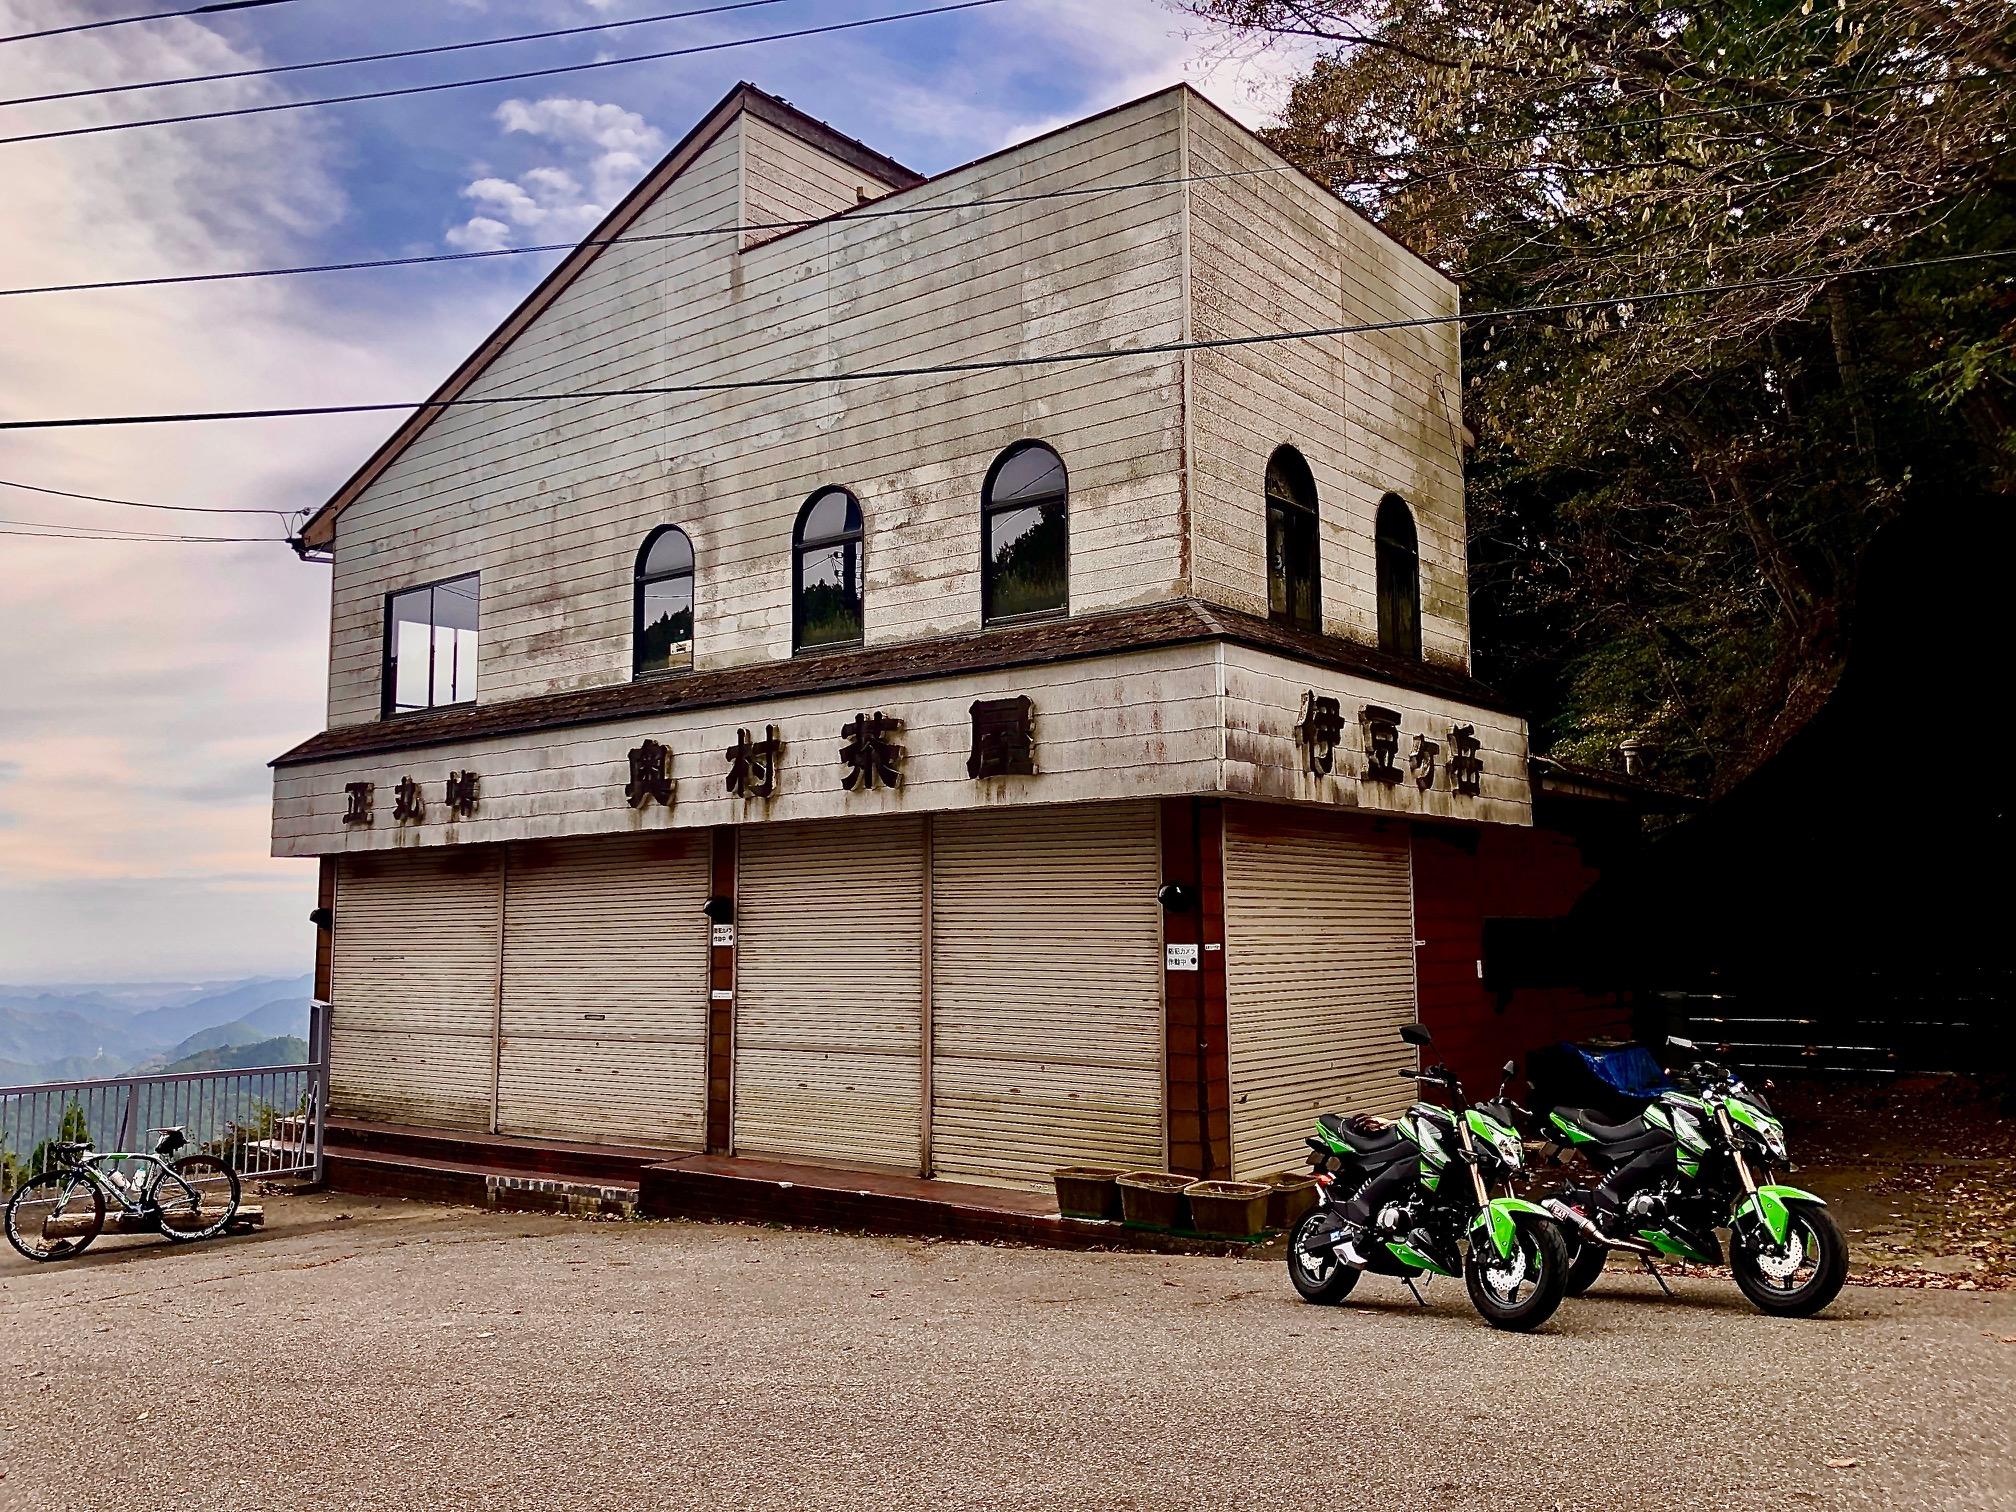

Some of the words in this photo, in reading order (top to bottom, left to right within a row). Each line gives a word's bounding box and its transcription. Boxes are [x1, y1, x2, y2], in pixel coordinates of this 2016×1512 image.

[342, 769, 480, 825] 正丸峠
[625, 694, 1039, 809] 奥村茶屋
[1168, 947, 1195, 955] 防犯カメラ
